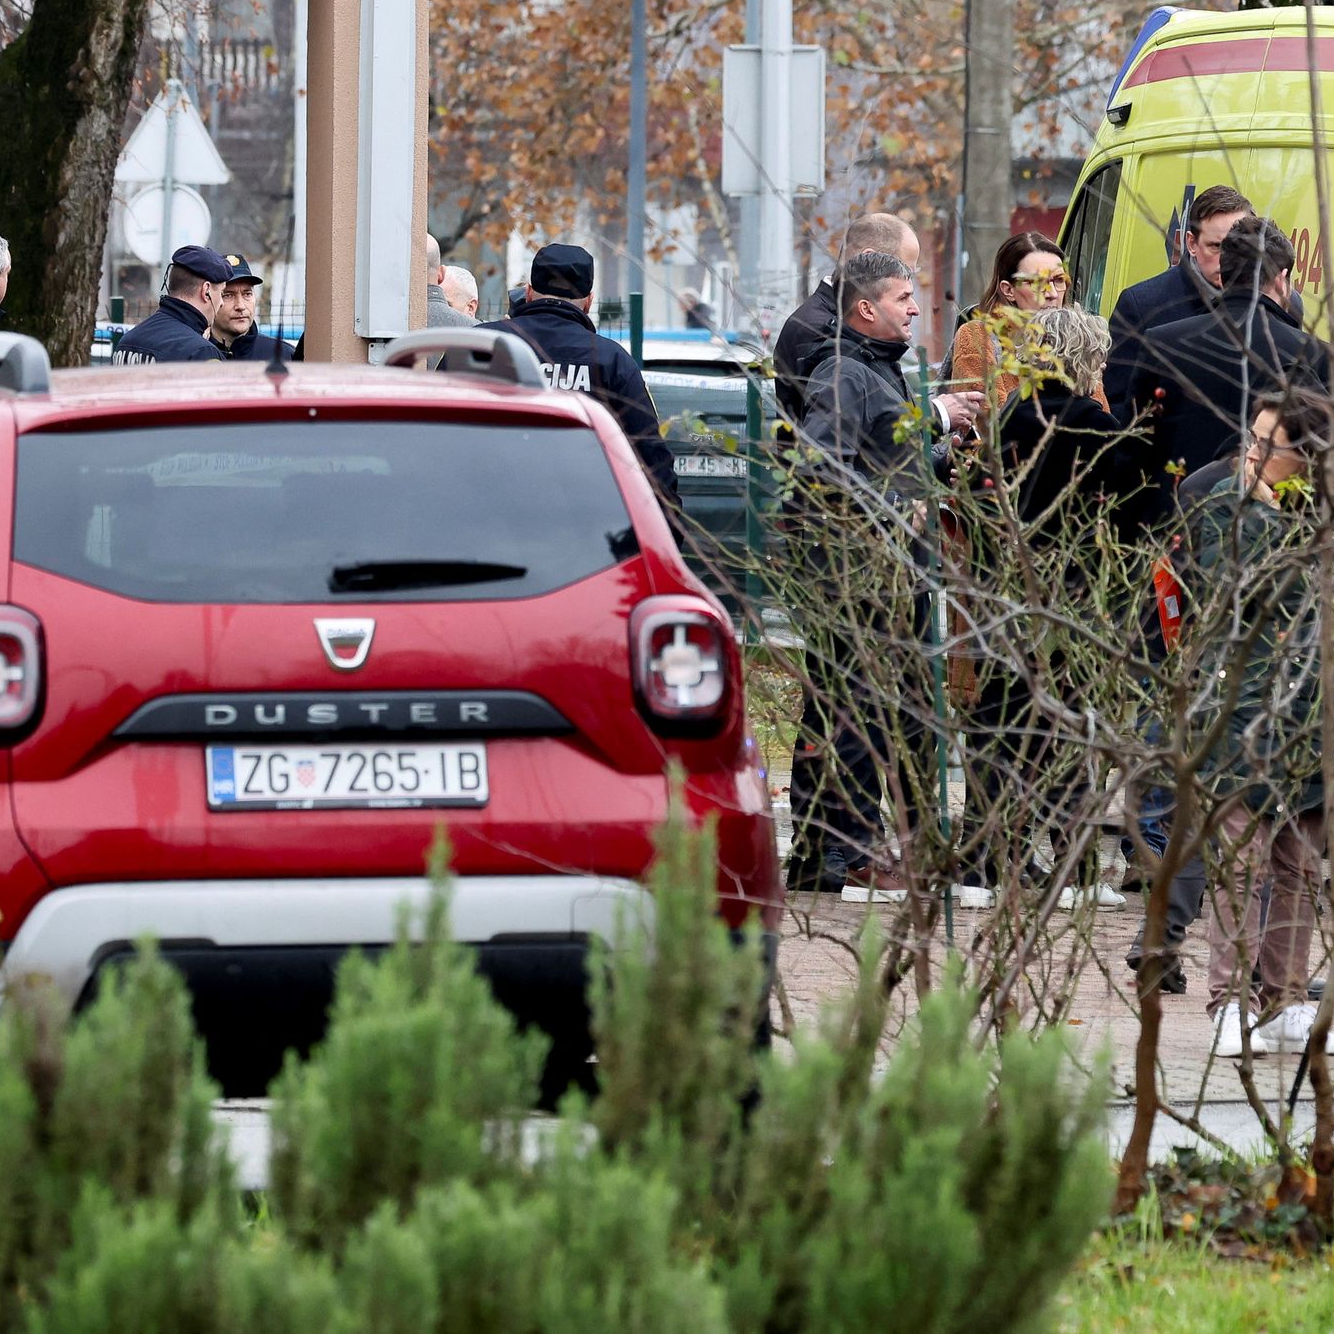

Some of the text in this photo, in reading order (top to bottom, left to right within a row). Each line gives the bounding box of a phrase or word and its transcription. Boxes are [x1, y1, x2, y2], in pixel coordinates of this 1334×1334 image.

[1290, 228, 1323, 294] 94
[539, 362, 591, 392] CIJA
[204, 701, 489, 726] DUSTER
[241, 753, 290, 794] ZG
